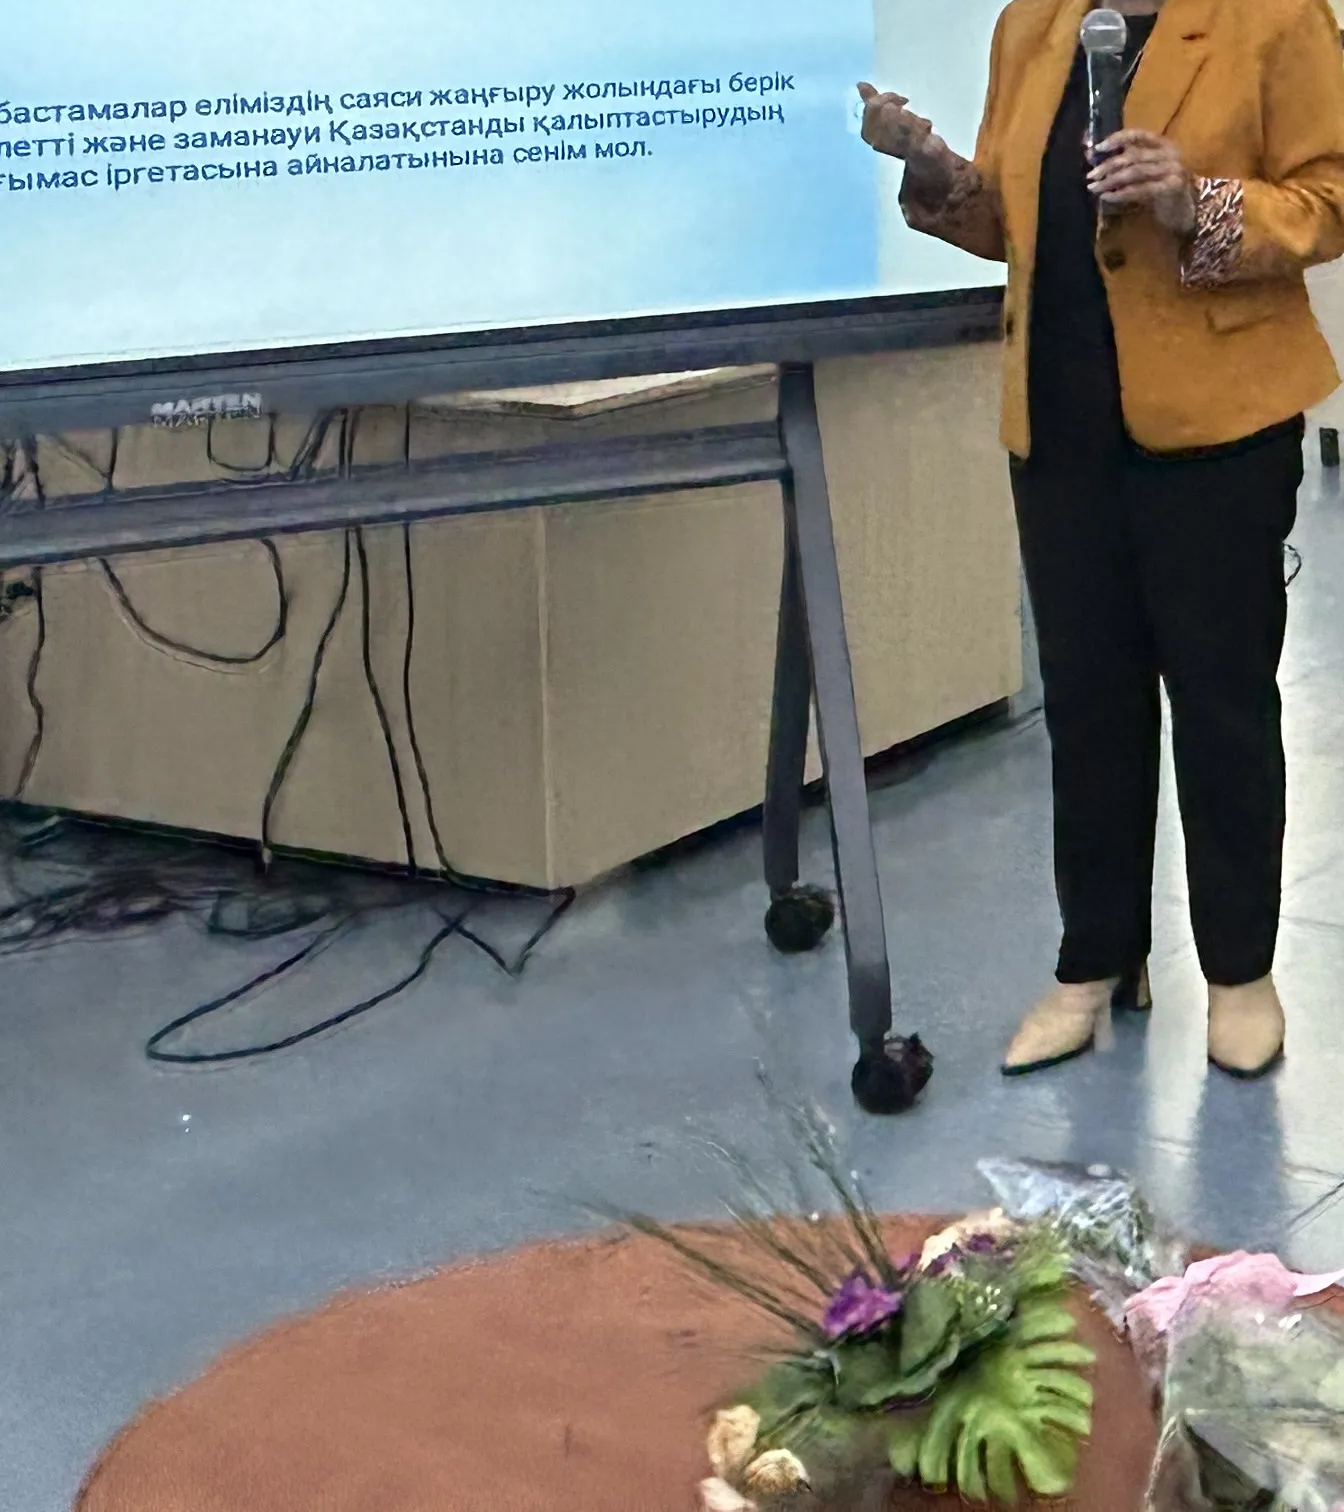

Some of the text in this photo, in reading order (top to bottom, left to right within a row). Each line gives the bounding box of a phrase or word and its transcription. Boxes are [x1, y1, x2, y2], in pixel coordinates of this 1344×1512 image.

[194, 89, 334, 117] еліміздің
[339, 90, 423, 111] саяси
[428, 83, 556, 109] жаңғыру
[561, 77, 721, 101] жолындағы
[728, 70, 796, 97] берік
[82, 133, 167, 156] және
[172, 125, 321, 151] заманауи
[328, 106, 525, 147] Қазақстанды
[532, 103, 785, 137] қалыптастырудың
[106, 159, 279, 193] іргетасына
[286, 147, 505, 177] айналатынына
[512, 139, 587, 165] сенім
[594, 140, 653, 159] мол.
